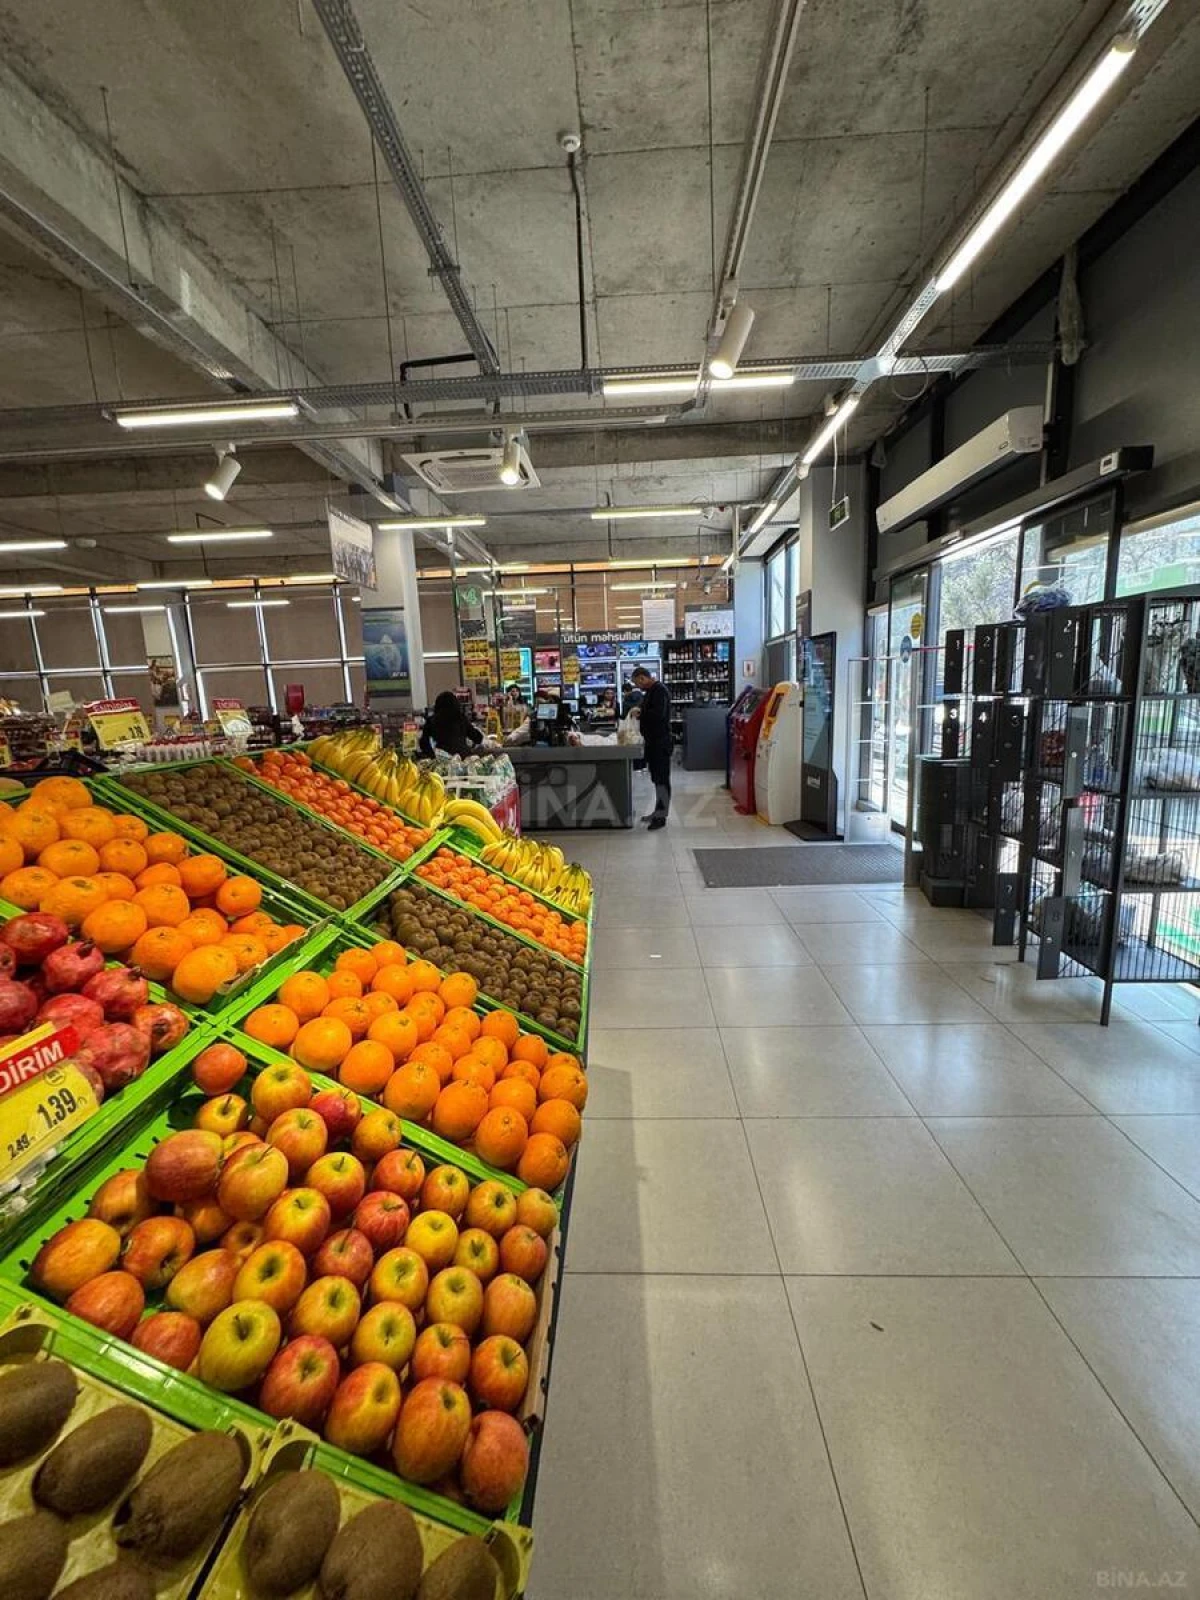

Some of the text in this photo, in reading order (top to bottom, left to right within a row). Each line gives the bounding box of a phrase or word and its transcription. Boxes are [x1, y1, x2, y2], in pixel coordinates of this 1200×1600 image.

[1063, 619, 1072, 633] 2
[949, 707, 958, 719] 3
[978, 711, 987, 723] 4
[37, 1088, 77, 1129] 1.39
